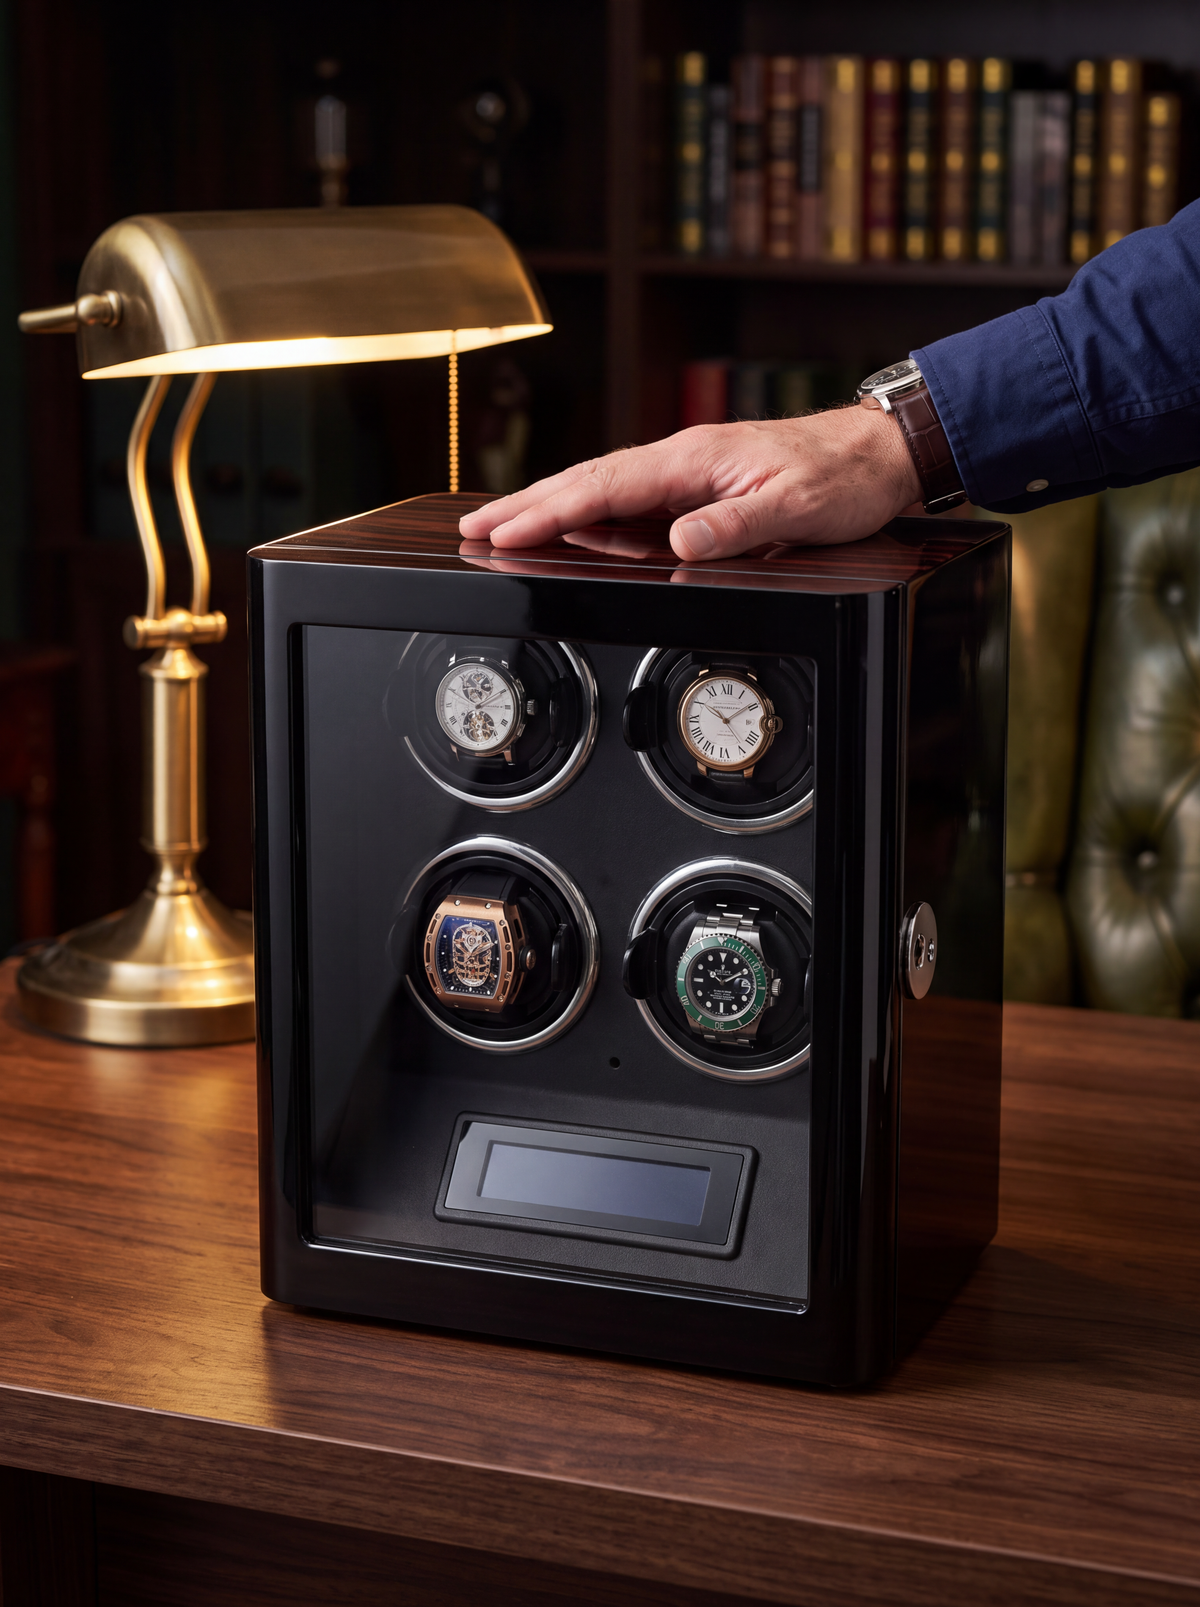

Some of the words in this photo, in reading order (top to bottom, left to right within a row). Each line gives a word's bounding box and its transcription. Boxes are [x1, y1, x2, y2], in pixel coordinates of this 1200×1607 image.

[705, 685, 717, 699] XI
[721, 684, 733, 695] XII
[748, 702, 759, 712] II
[689, 714, 700, 723] IX
[691, 727, 704, 744] VIII
[745, 730, 760, 746] IIII
[702, 740, 715, 755] VII
[720, 747, 730, 758] VI
[738, 746, 746, 755] V
[714, 1021, 725, 1030] 30
